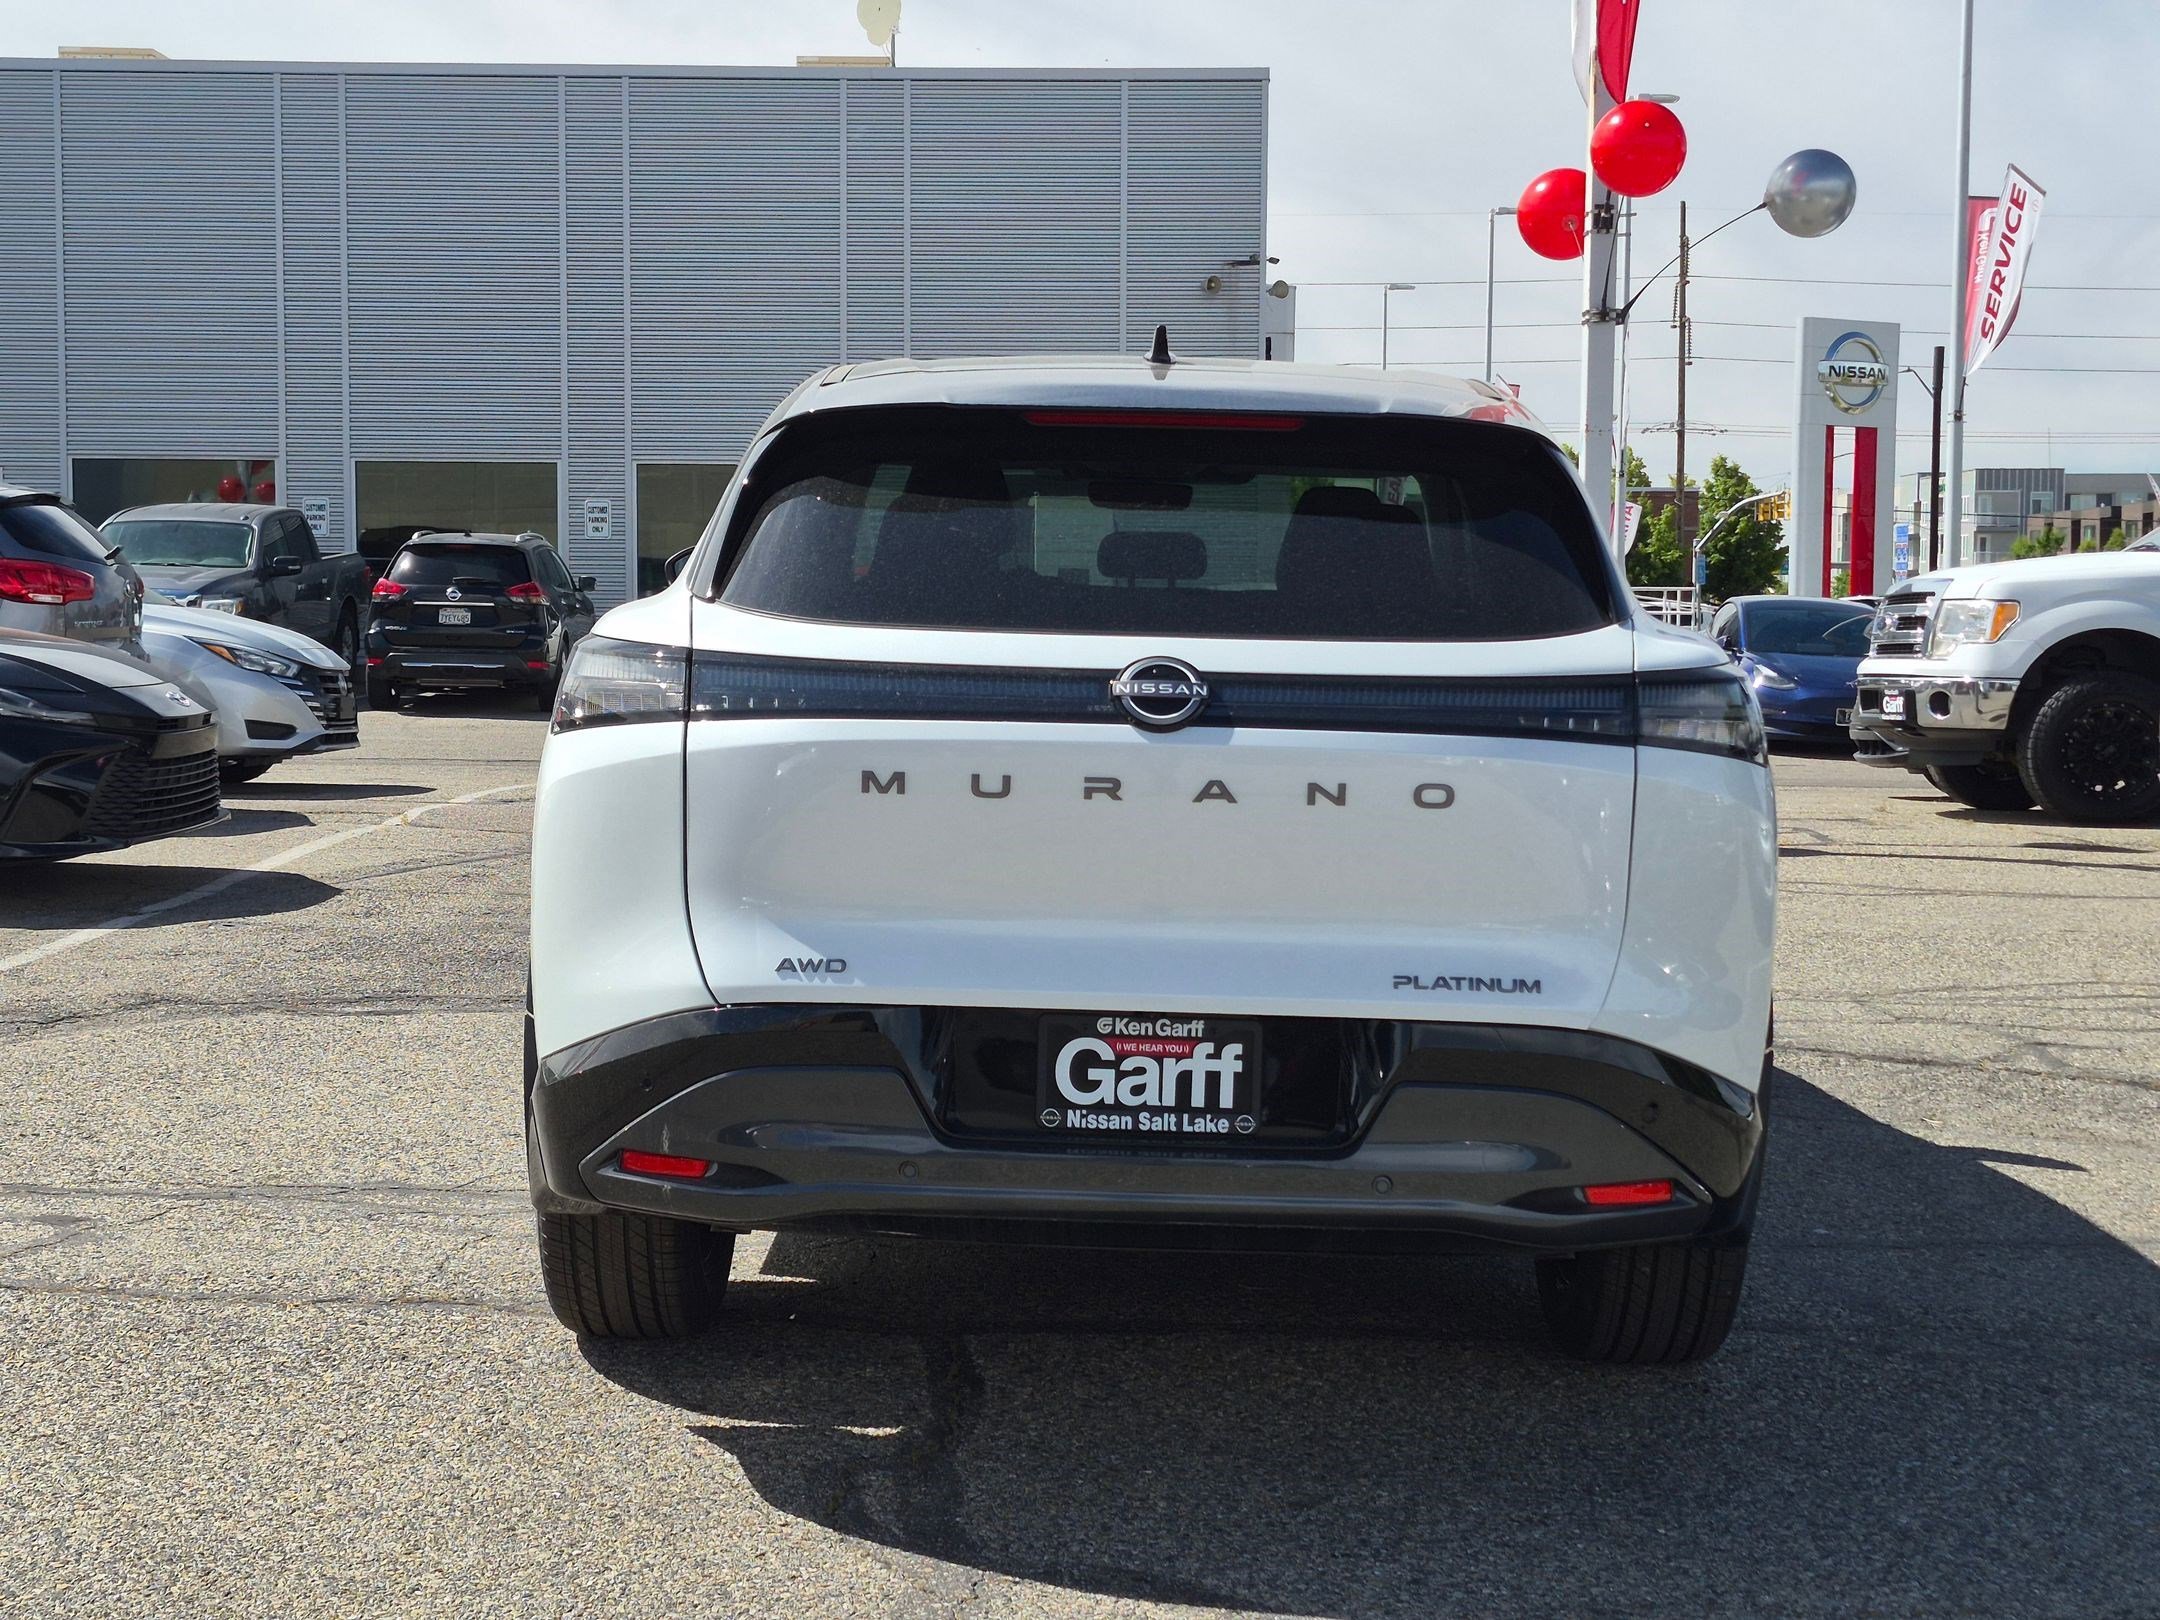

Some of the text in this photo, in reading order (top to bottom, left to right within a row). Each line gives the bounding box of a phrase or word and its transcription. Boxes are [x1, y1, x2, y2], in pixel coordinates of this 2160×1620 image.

[1980, 182, 2028, 343] SERVICE
[1828, 365, 1886, 380] NISSAN
[1115, 683, 1208, 697] NISSAN
[861, 770, 1455, 809] MURANO
[774, 957, 848, 974] AWD
[1393, 975, 1542, 994] PLATINUM
[1115, 1018, 1205, 1038] Ken Garff
[1123, 1043, 1184, 1053] WE HEAR YOU
[1055, 1037, 1243, 1109] Garff
[1066, 1109, 1230, 1134] Nissan Salt Lake
